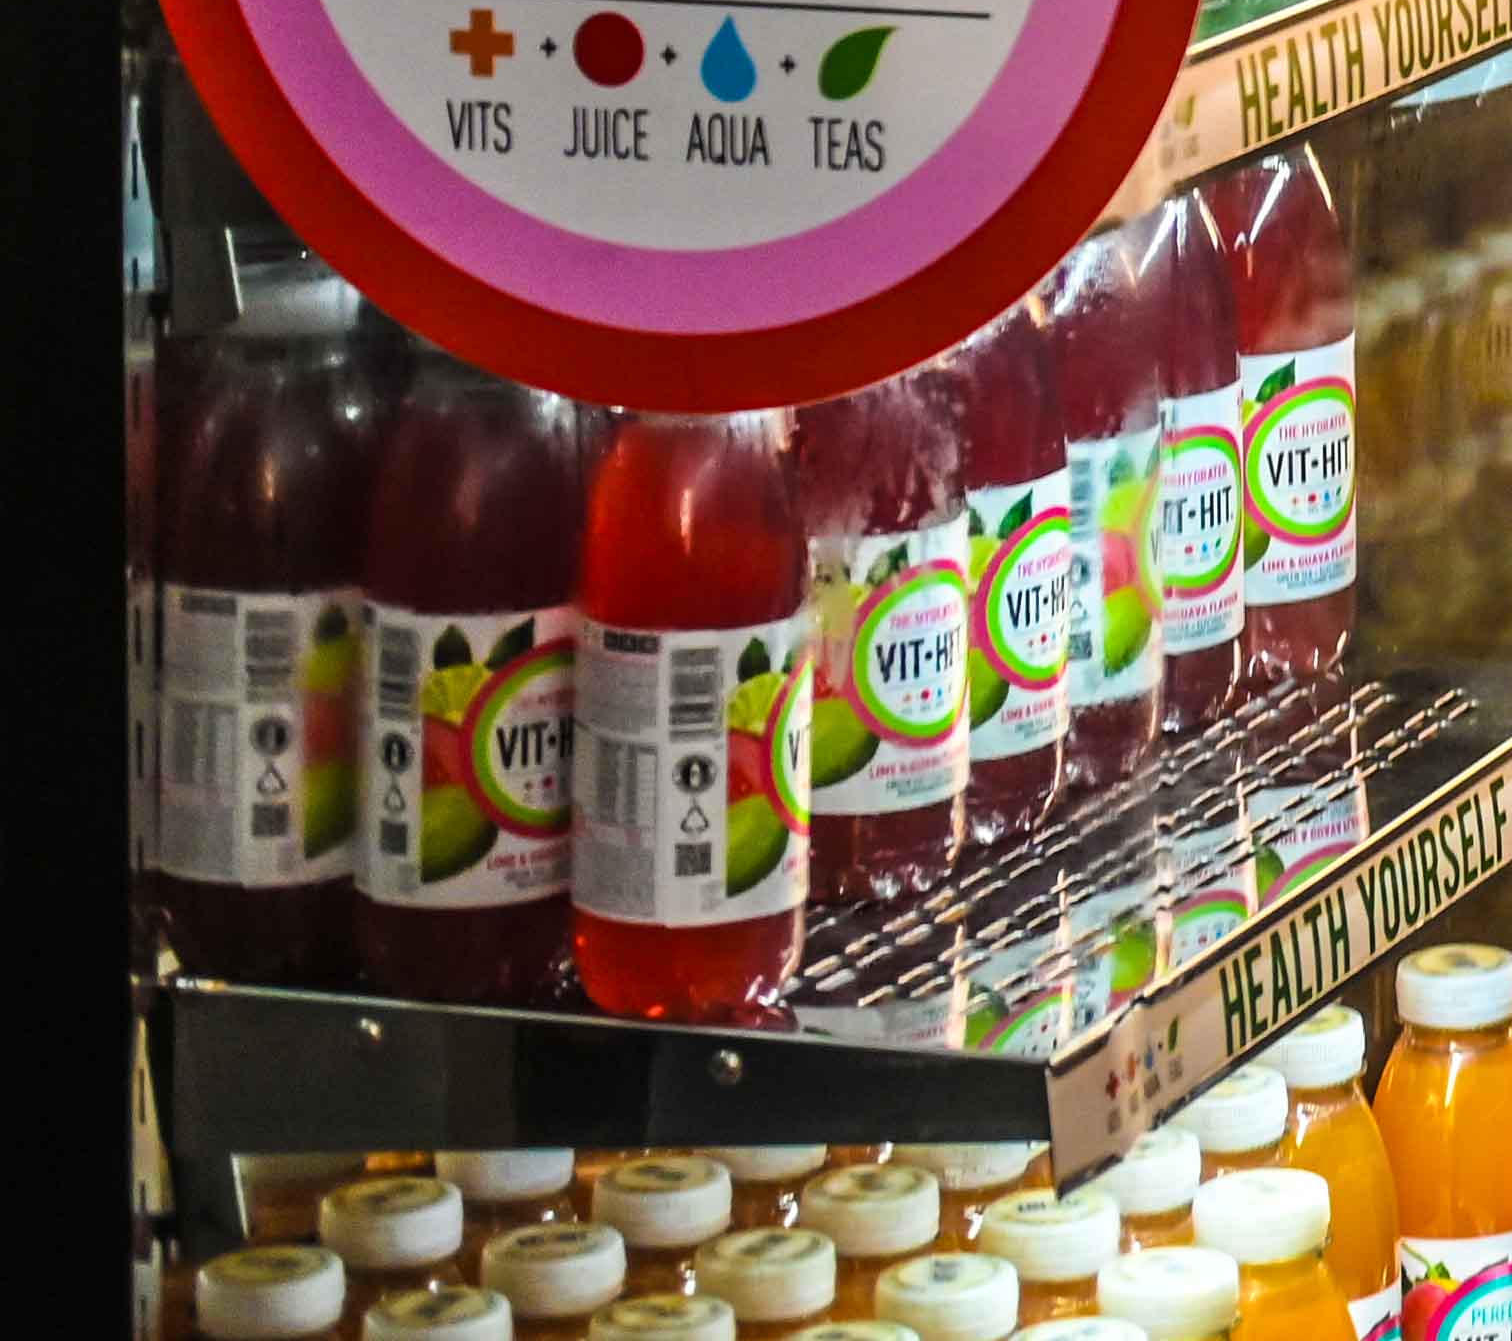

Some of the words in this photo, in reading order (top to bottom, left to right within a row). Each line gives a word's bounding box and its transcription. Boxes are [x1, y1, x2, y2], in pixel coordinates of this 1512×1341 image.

[447, 99, 513, 155] VITS
[563, 108, 649, 162] JUICE
[686, 113, 770, 166] AQUA
[809, 116, 887, 173] TEAS
[1235, 23, 1367, 149] HEALTH
[1218, 900, 1352, 1057] HEALTH
[1357, 776, 1508, 954] YOURSELF
